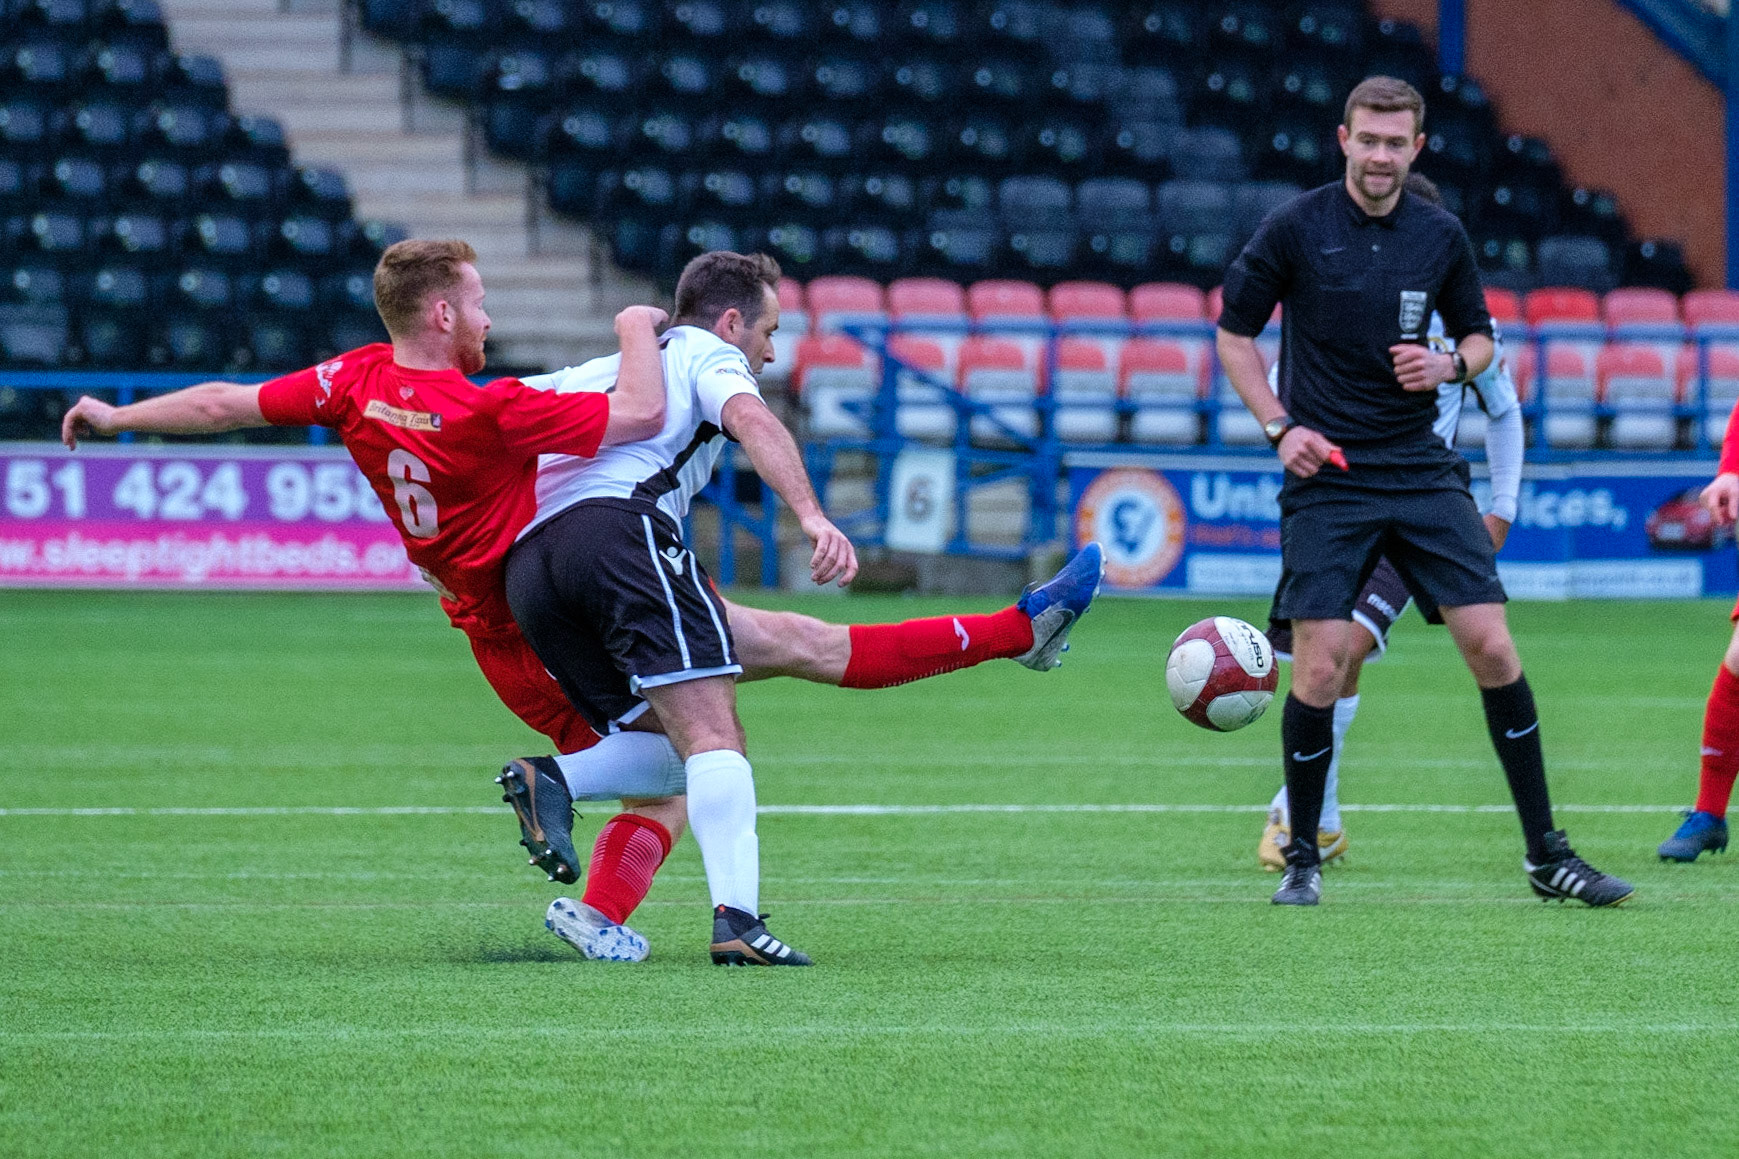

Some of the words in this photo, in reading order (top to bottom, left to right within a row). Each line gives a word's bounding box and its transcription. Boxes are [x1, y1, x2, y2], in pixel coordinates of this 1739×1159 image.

[5, 460, 86, 519] 51
[113, 461, 247, 520] 424
[388, 449, 441, 538] 6
[903, 474, 934, 522] 6
